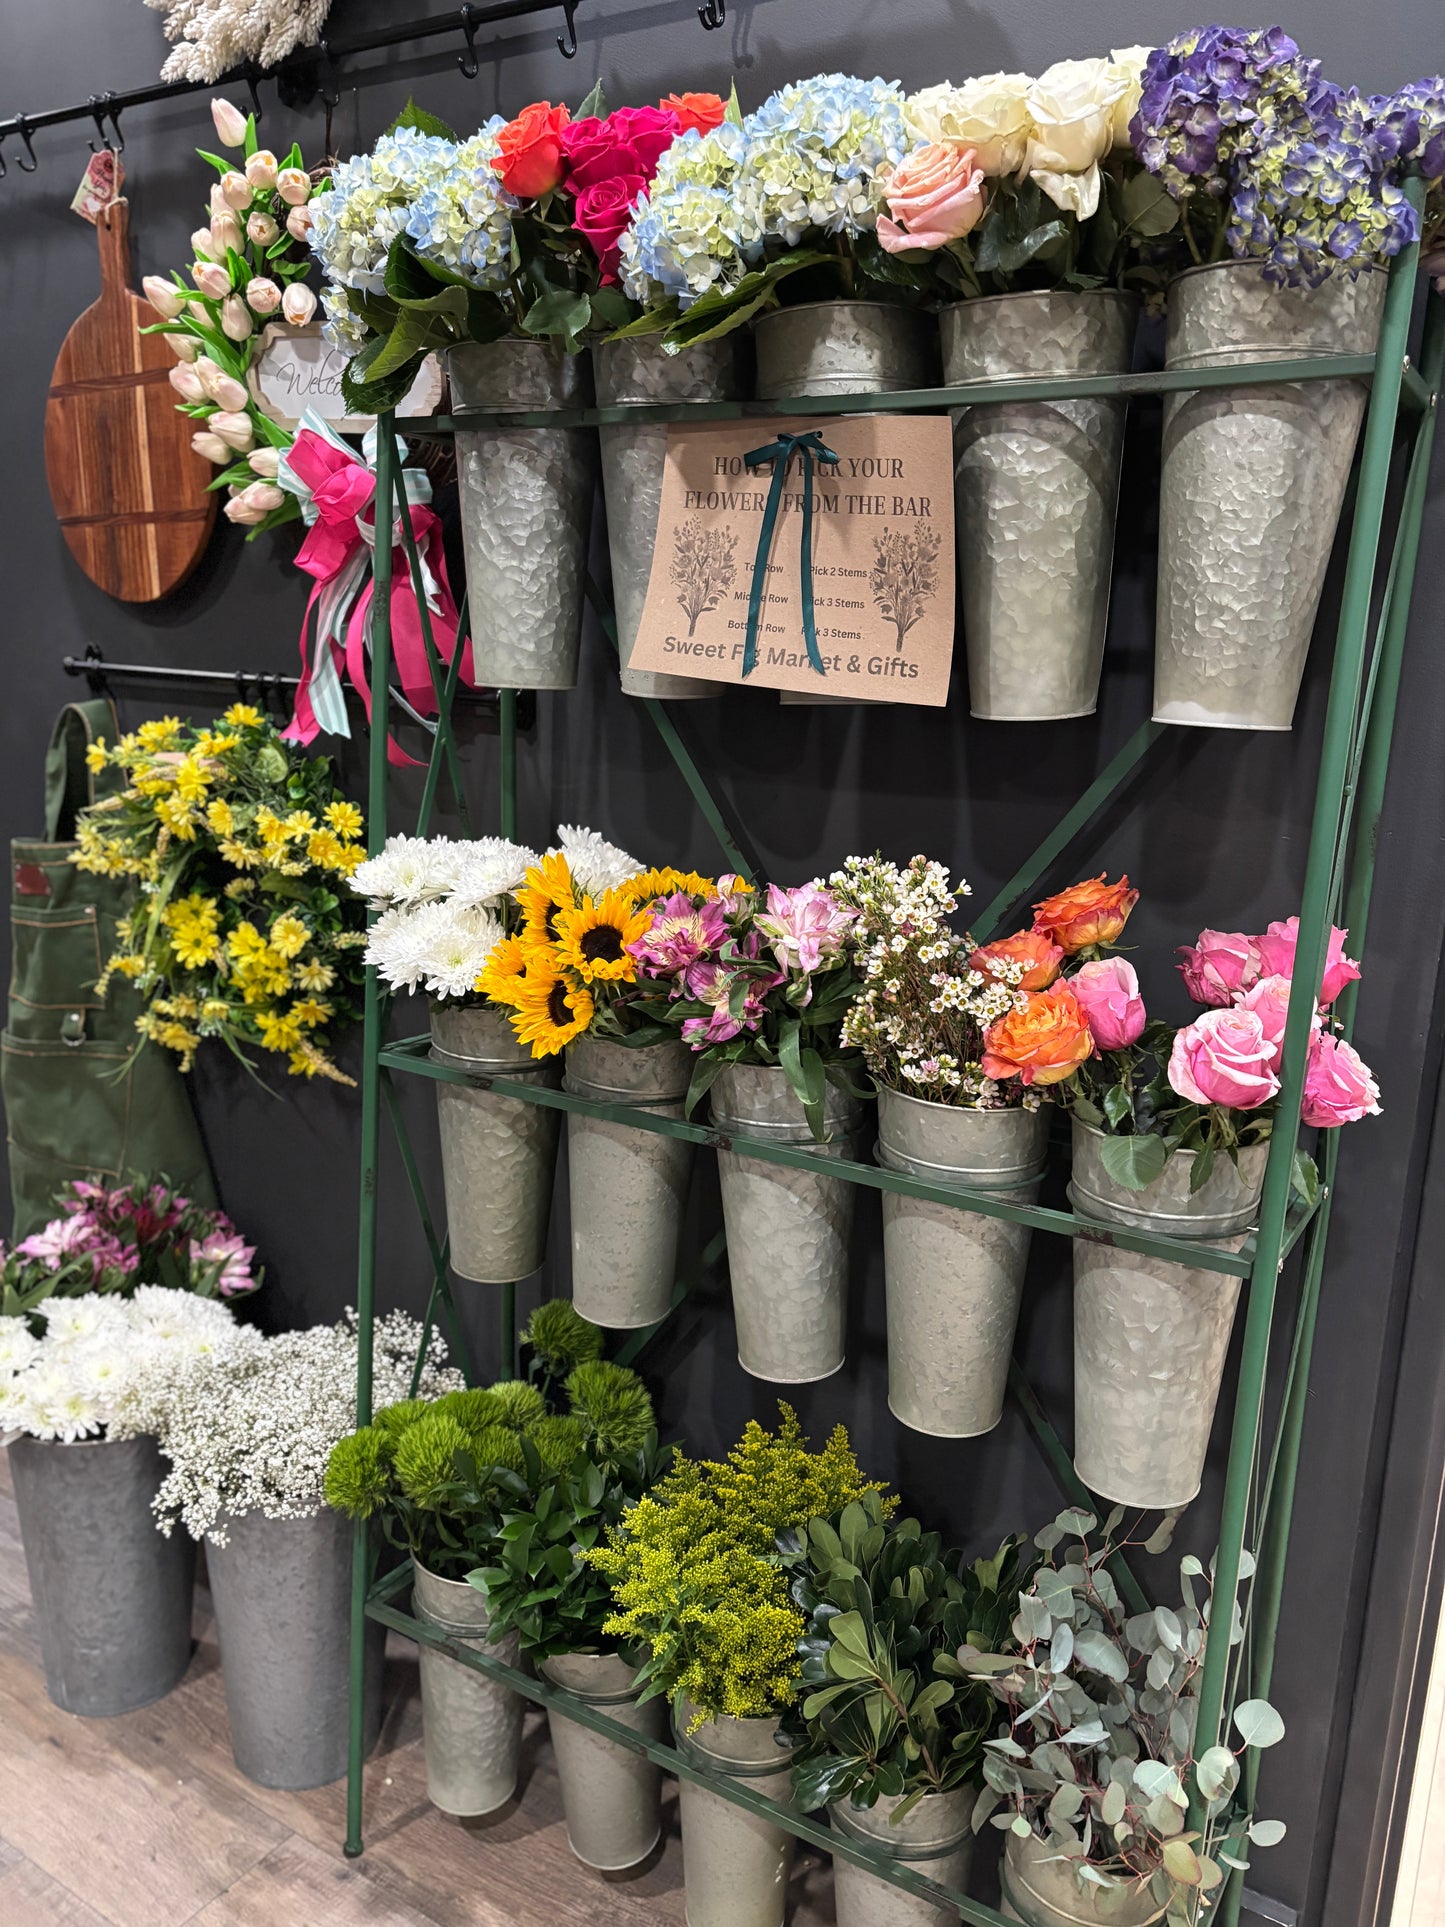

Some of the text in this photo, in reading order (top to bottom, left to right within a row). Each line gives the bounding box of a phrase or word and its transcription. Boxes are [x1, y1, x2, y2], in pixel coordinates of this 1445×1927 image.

[276, 349, 344, 396] Welco
[848, 457, 904, 478] YOUR
[683, 490, 932, 518] FLOWER FROM THE BAR
[765, 563, 784, 574] Row
[810, 565, 829, 576] Pick
[830, 567, 836, 577] 2
[837, 567, 868, 578] Stems
[768, 593, 789, 604] Row
[826, 597, 833, 607] 3
[834, 598, 865, 609] Stems
[727, 620, 763, 632] Bottm
[765, 623, 786, 634] Row
[822, 628, 829, 638] 3
[830, 628, 862, 640] Stems
[663, 636, 727, 659] Sweet
[766, 647, 842, 672] Maret
[846, 654, 861, 674] &
[867, 656, 919, 678] Gifts
